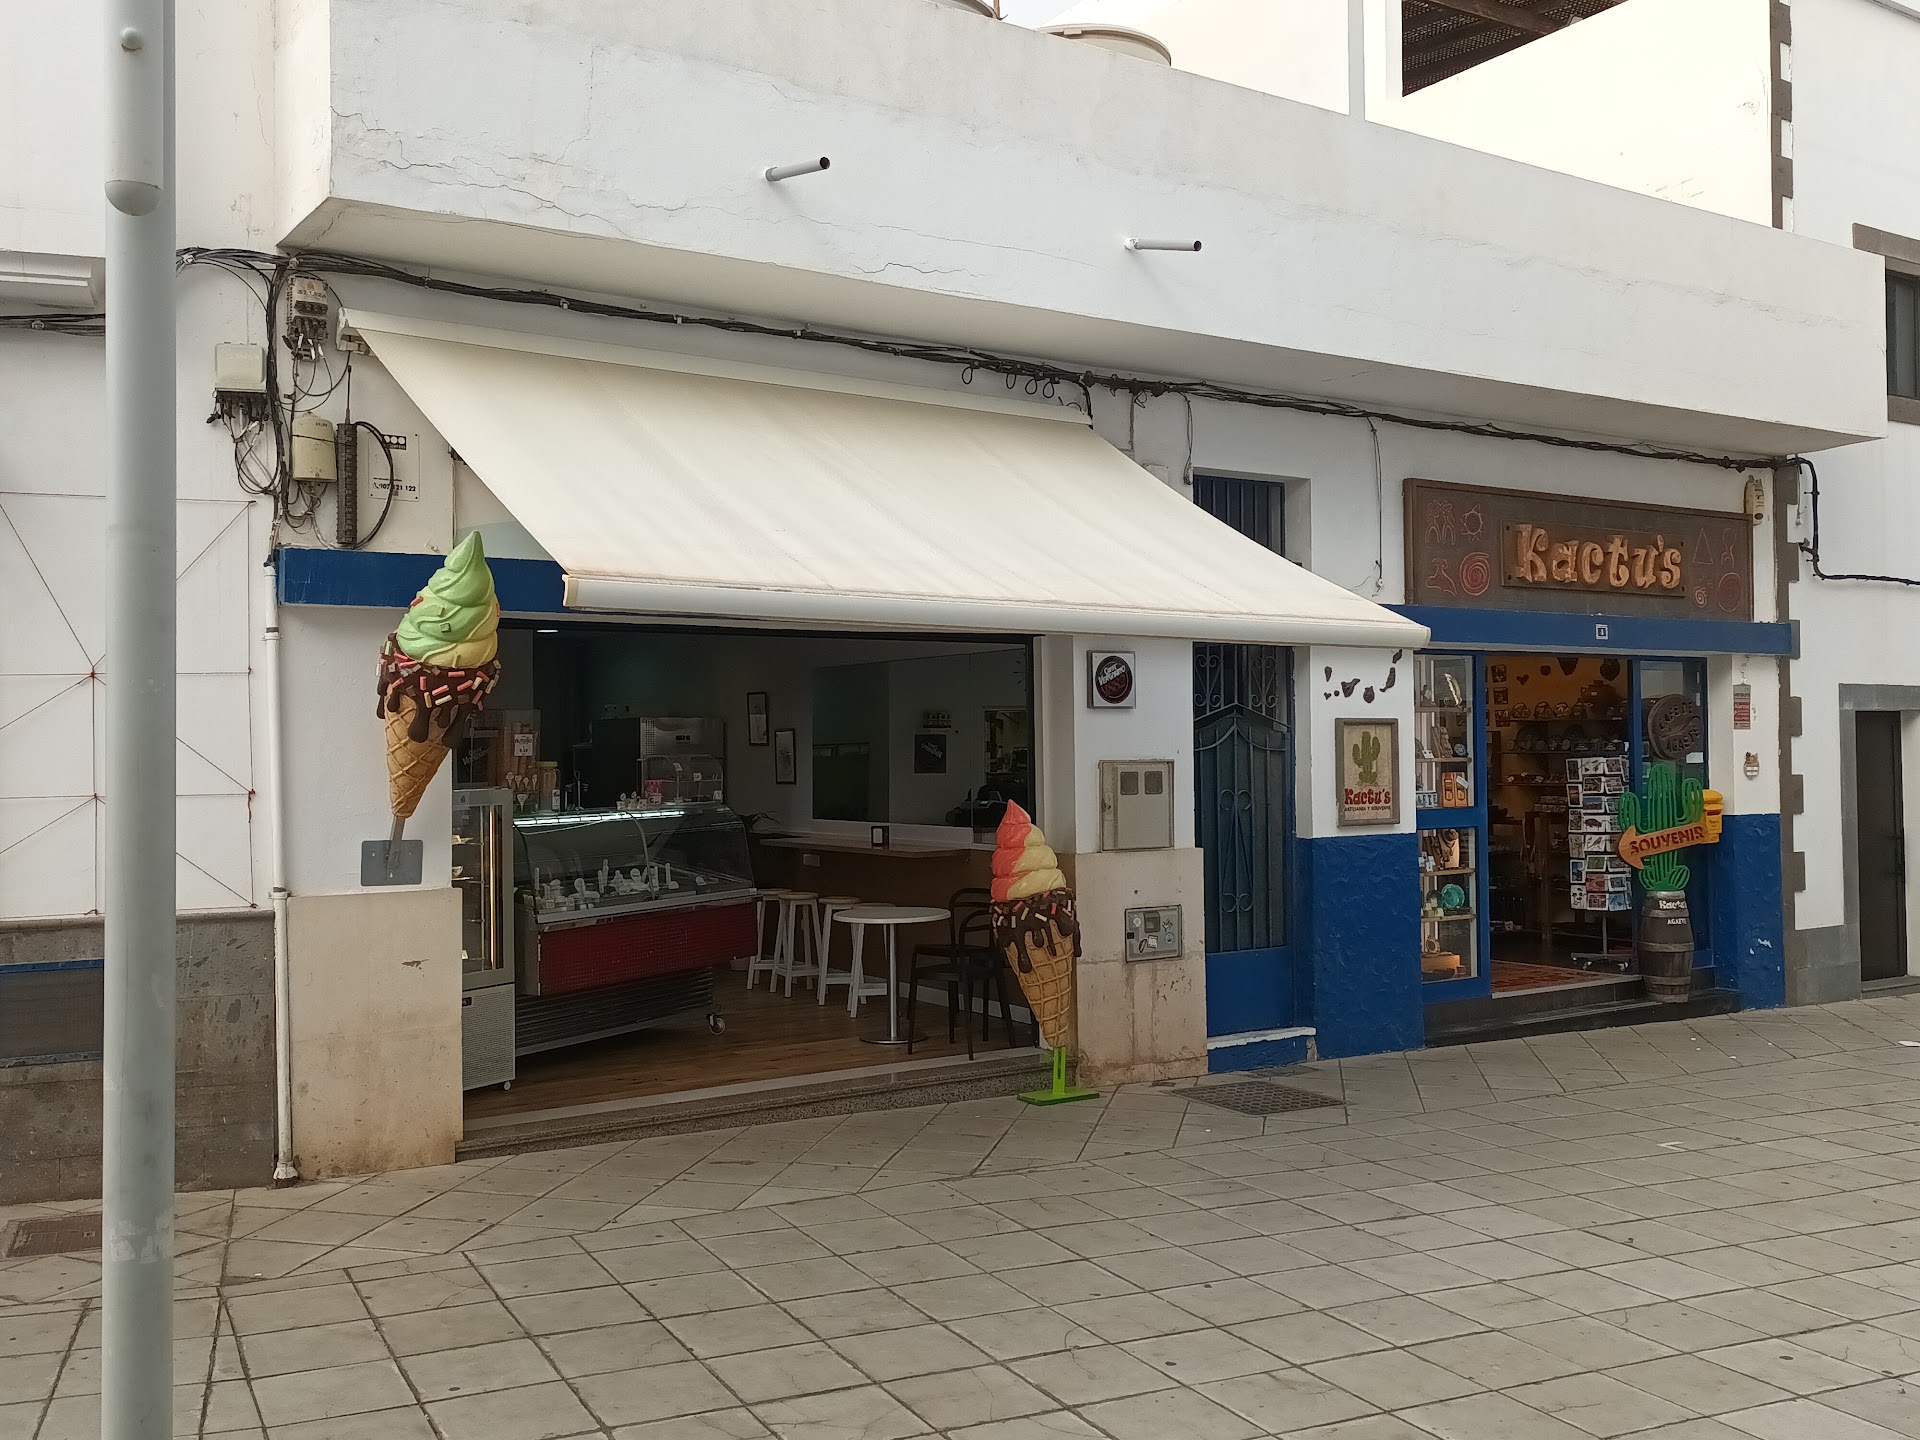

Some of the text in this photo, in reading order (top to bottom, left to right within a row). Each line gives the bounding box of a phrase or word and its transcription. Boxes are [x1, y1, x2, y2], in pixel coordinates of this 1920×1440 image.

[1514, 523, 1682, 588] Kactu's
[1344, 788, 1391, 805] Kactu's
[1629, 826, 1705, 856] SOUVENIR
